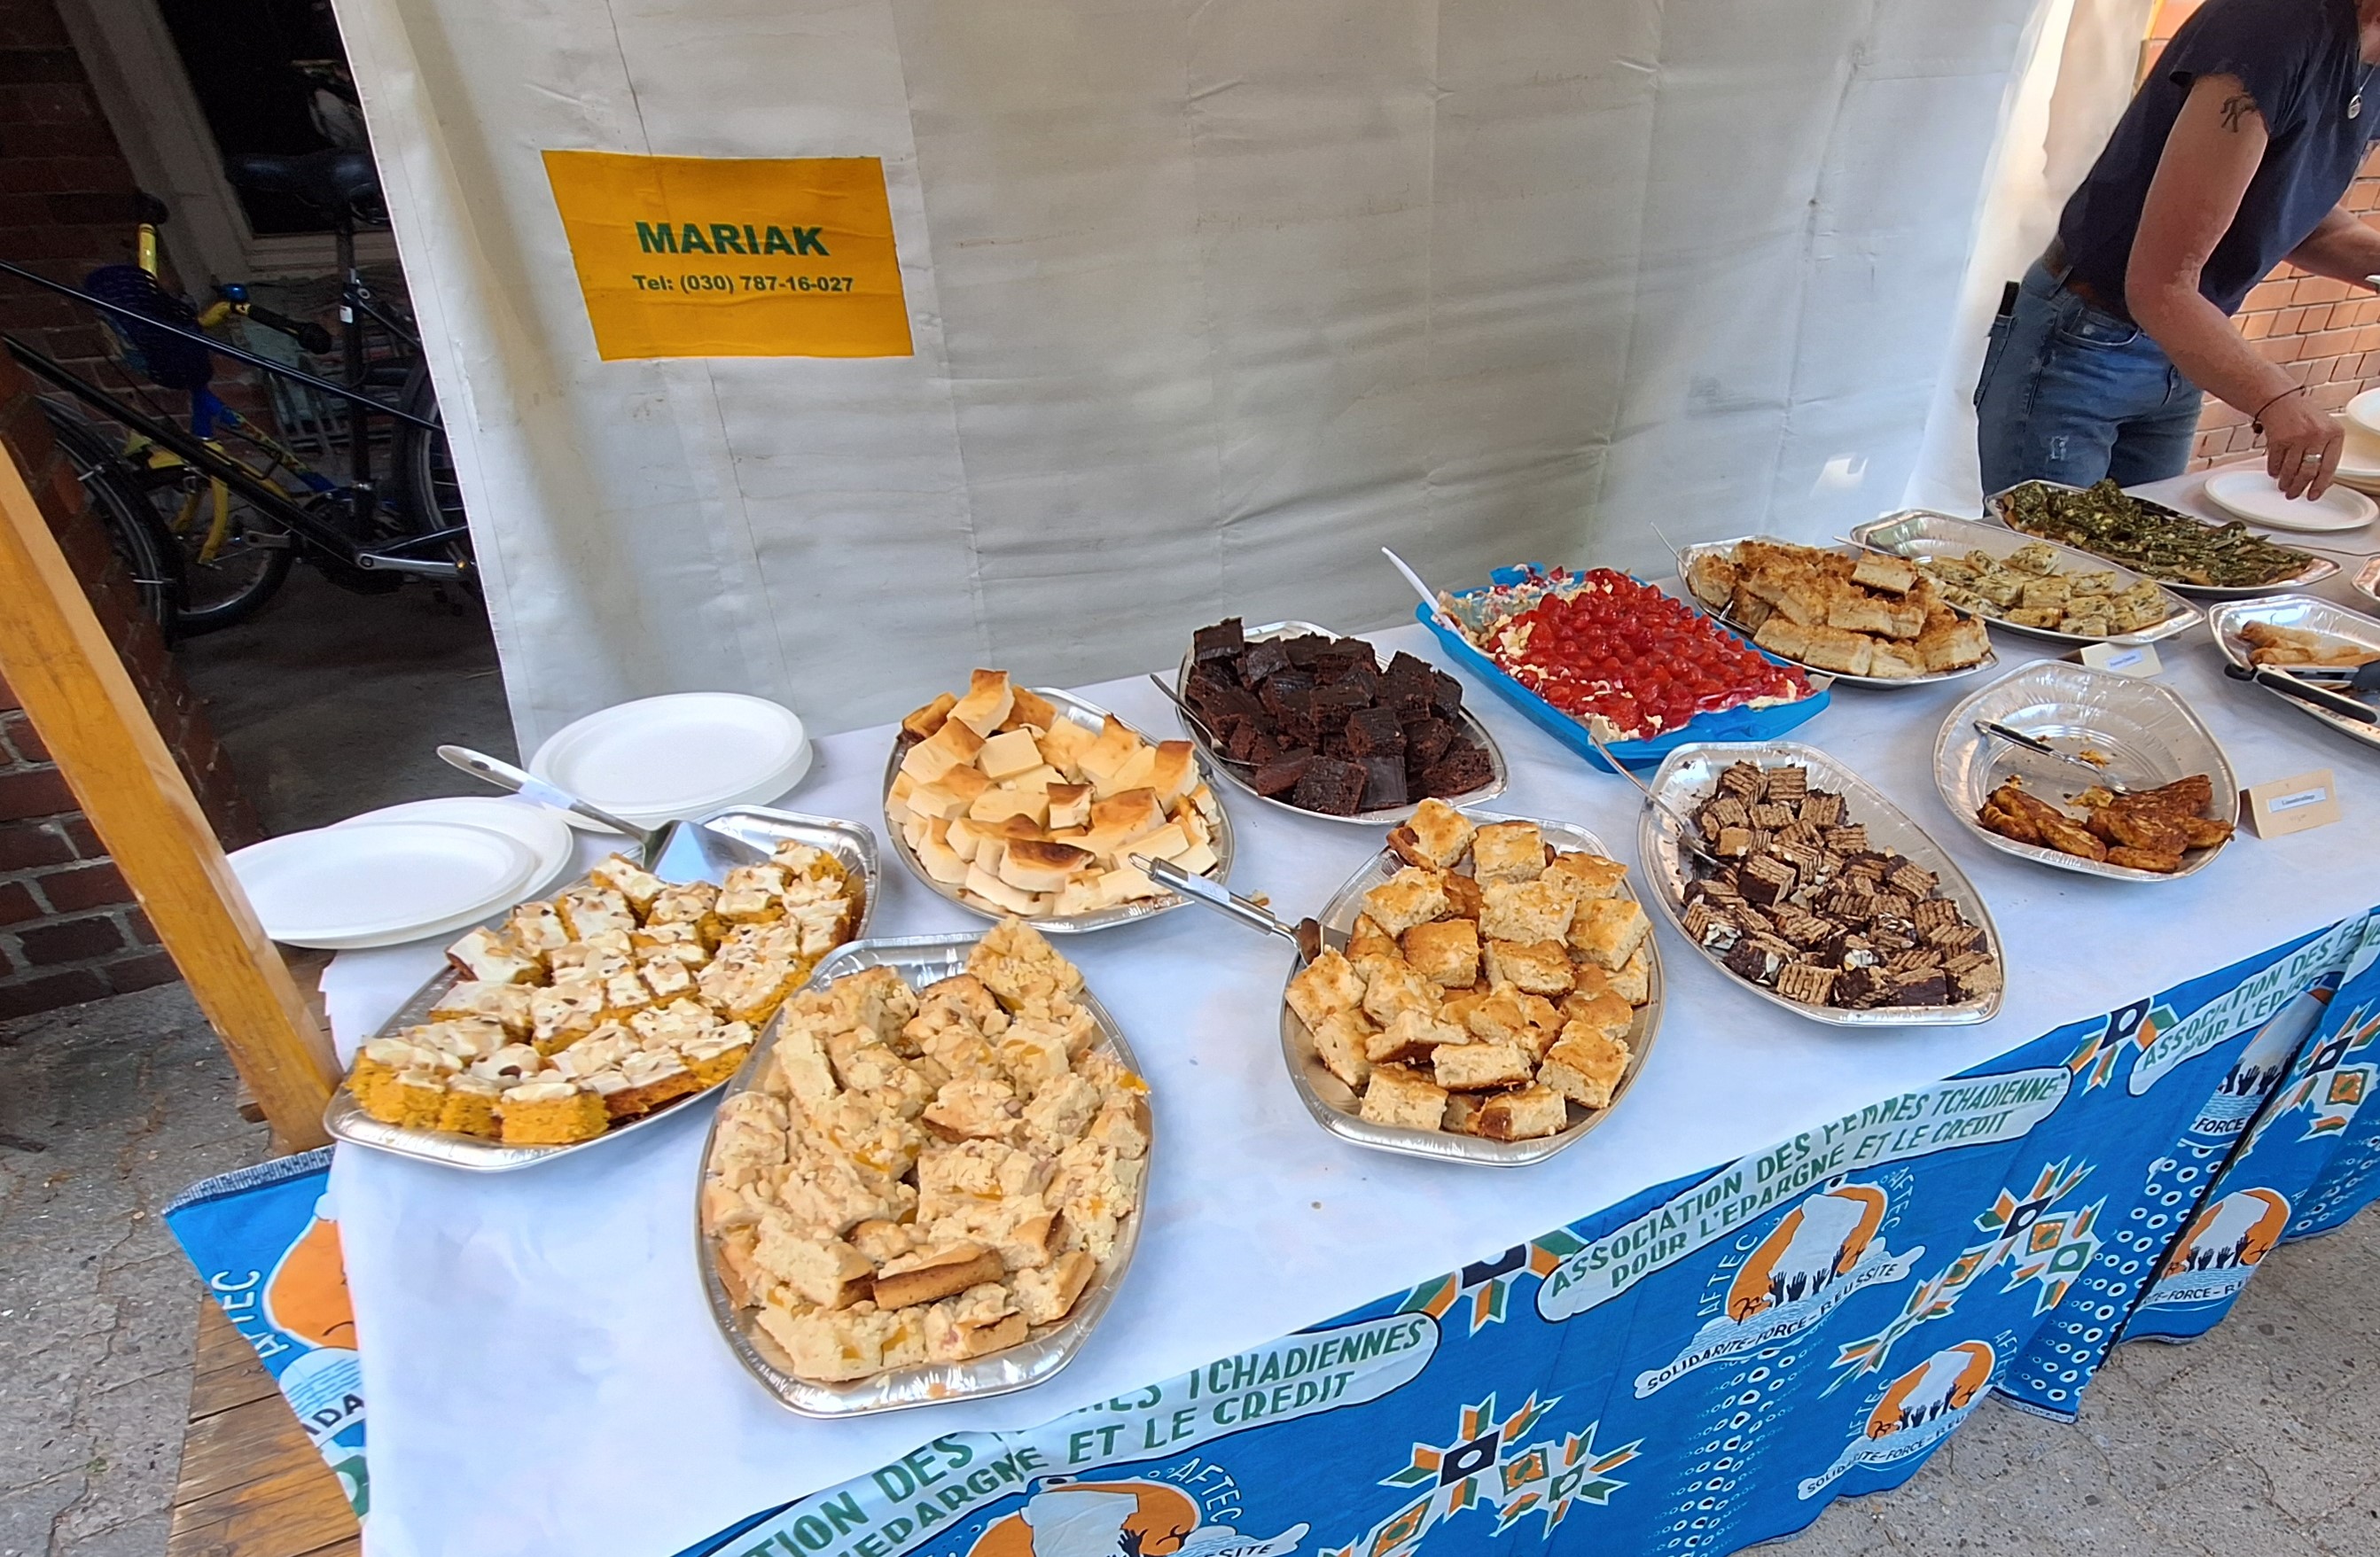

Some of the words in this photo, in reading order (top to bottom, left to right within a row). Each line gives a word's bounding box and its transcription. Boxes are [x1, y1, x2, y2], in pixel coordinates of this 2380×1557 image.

[635, 222, 831, 256] MARIAK
[632, 274, 674, 291] Tel:
[680, 275, 734, 294] (030)
[739, 276, 854, 292] 787-16-027
[2290, 937, 2333, 979] DES
[1551, 1171, 1743, 1297] ASSOCIATION
[1756, 1132, 1811, 1184] DES
[1931, 1074, 2068, 1117] TCHADIENNE
[1611, 1231, 1687, 1288] POUR
[1700, 1142, 1845, 1237] L'EPARGNE
[1853, 1132, 1892, 1160] ET
[1891, 1125, 1931, 1152] LE
[1931, 1109, 2015, 1144] CREDIT
[1881, 1166, 1914, 1232] AFTEC
[1697, 1234, 1759, 1318] AFTEC
[1068, 1424, 1125, 1464] ET
[1143, 1407, 1195, 1449] LE
[1213, 1371, 1354, 1424] CREDIT
[1845, 1378, 1894, 1438] AFTEC
[871, 1432, 973, 1503] DES
[1168, 1458, 1242, 1523] AFTEC
